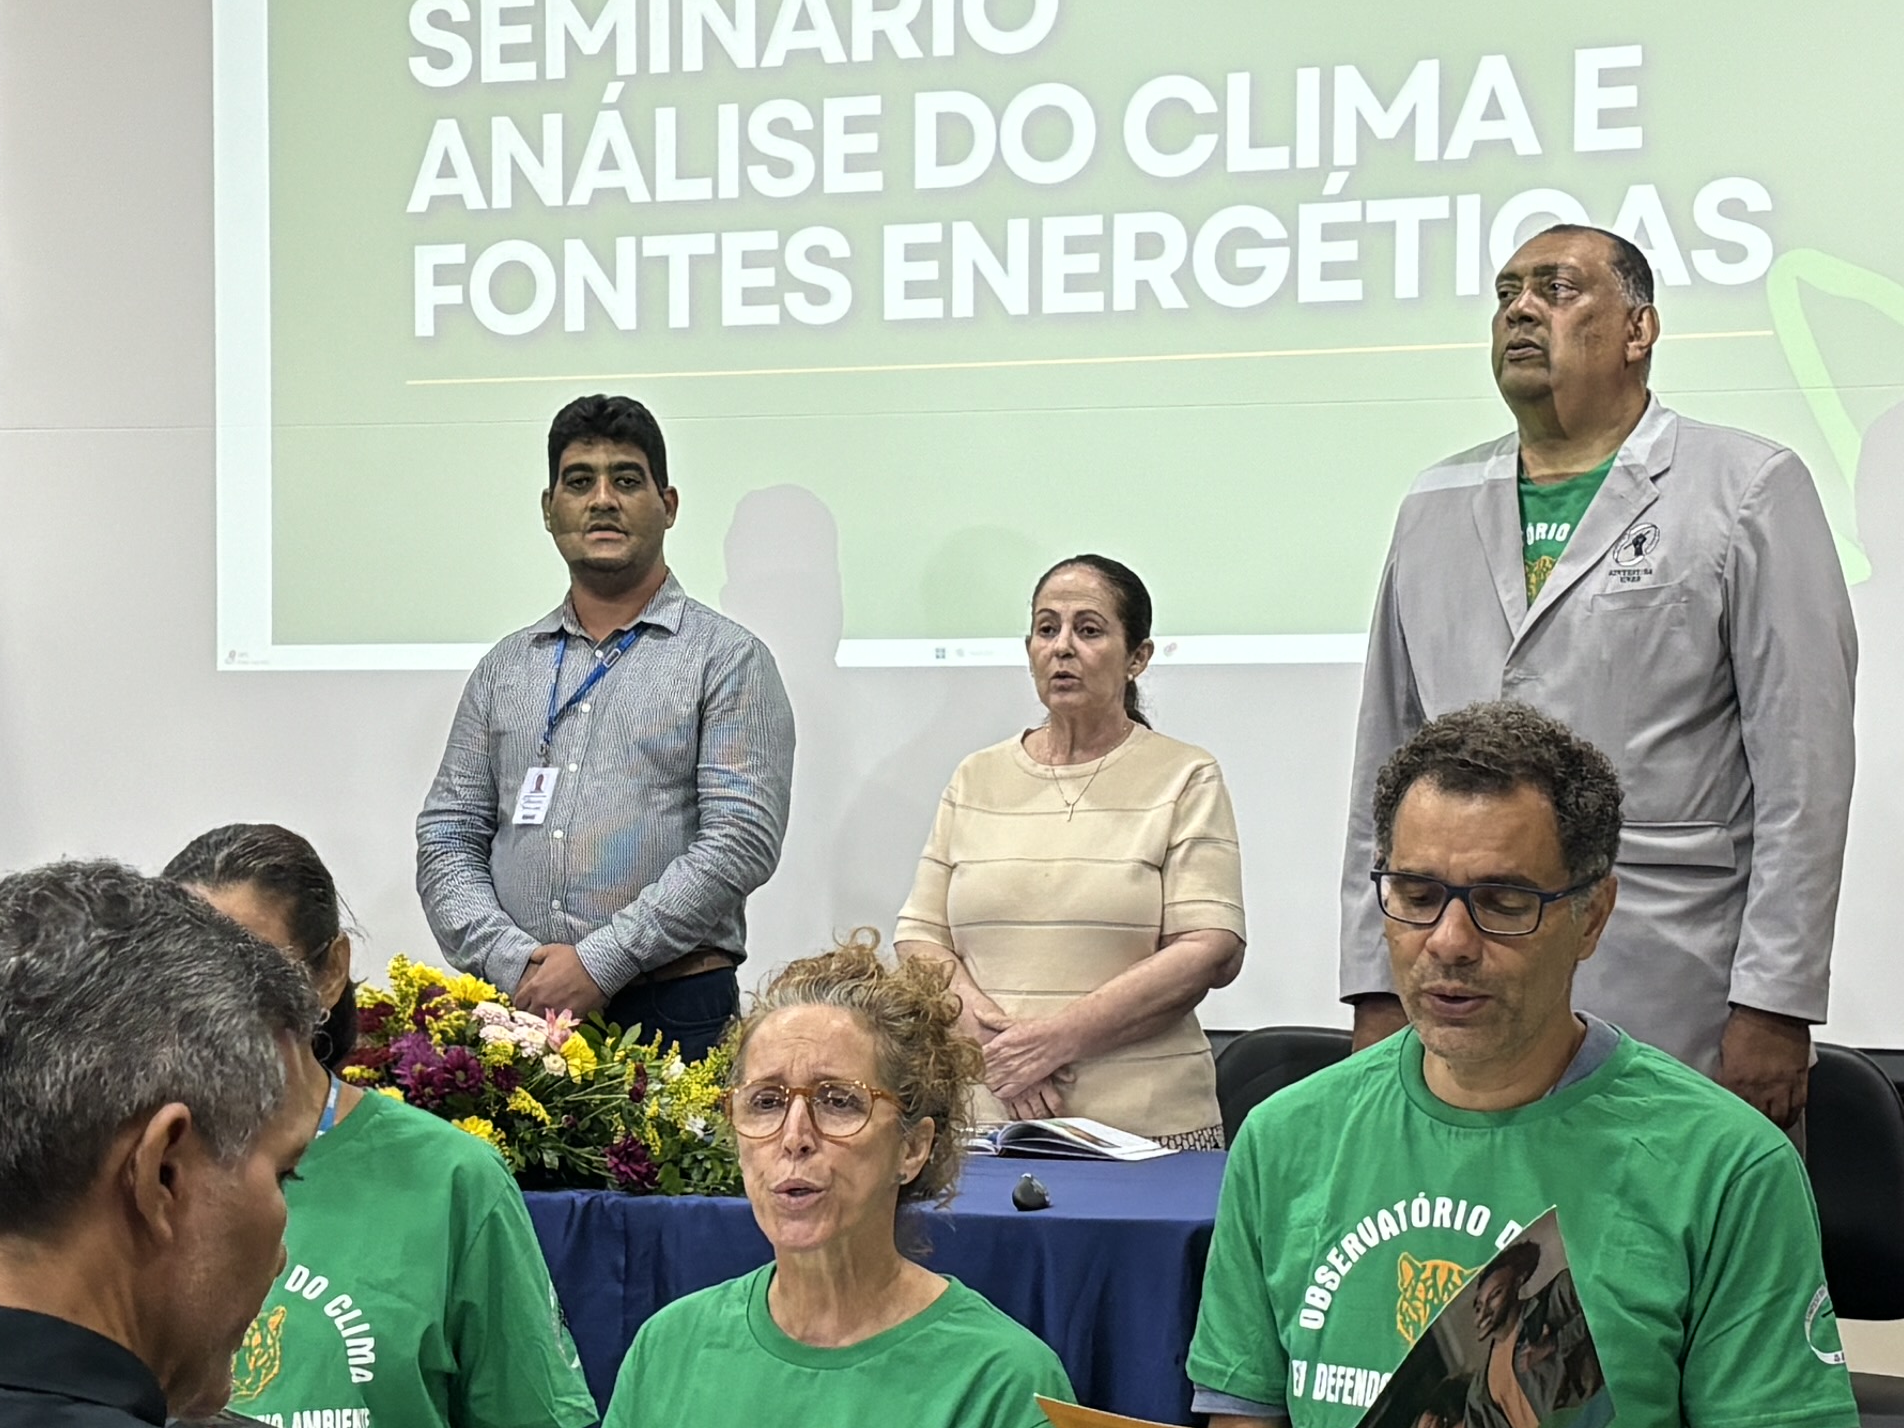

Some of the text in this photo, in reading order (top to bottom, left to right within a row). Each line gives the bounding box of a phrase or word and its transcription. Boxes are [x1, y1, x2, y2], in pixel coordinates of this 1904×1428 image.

[406, 44, 1643, 213] ANÁLISE DO CLIMA E
[414, 226, 853, 337] FONTES
[284, 1264, 376, 1383] DO CLIMA
[1299, 1191, 1491, 1330] OBSERVATÓRIO
